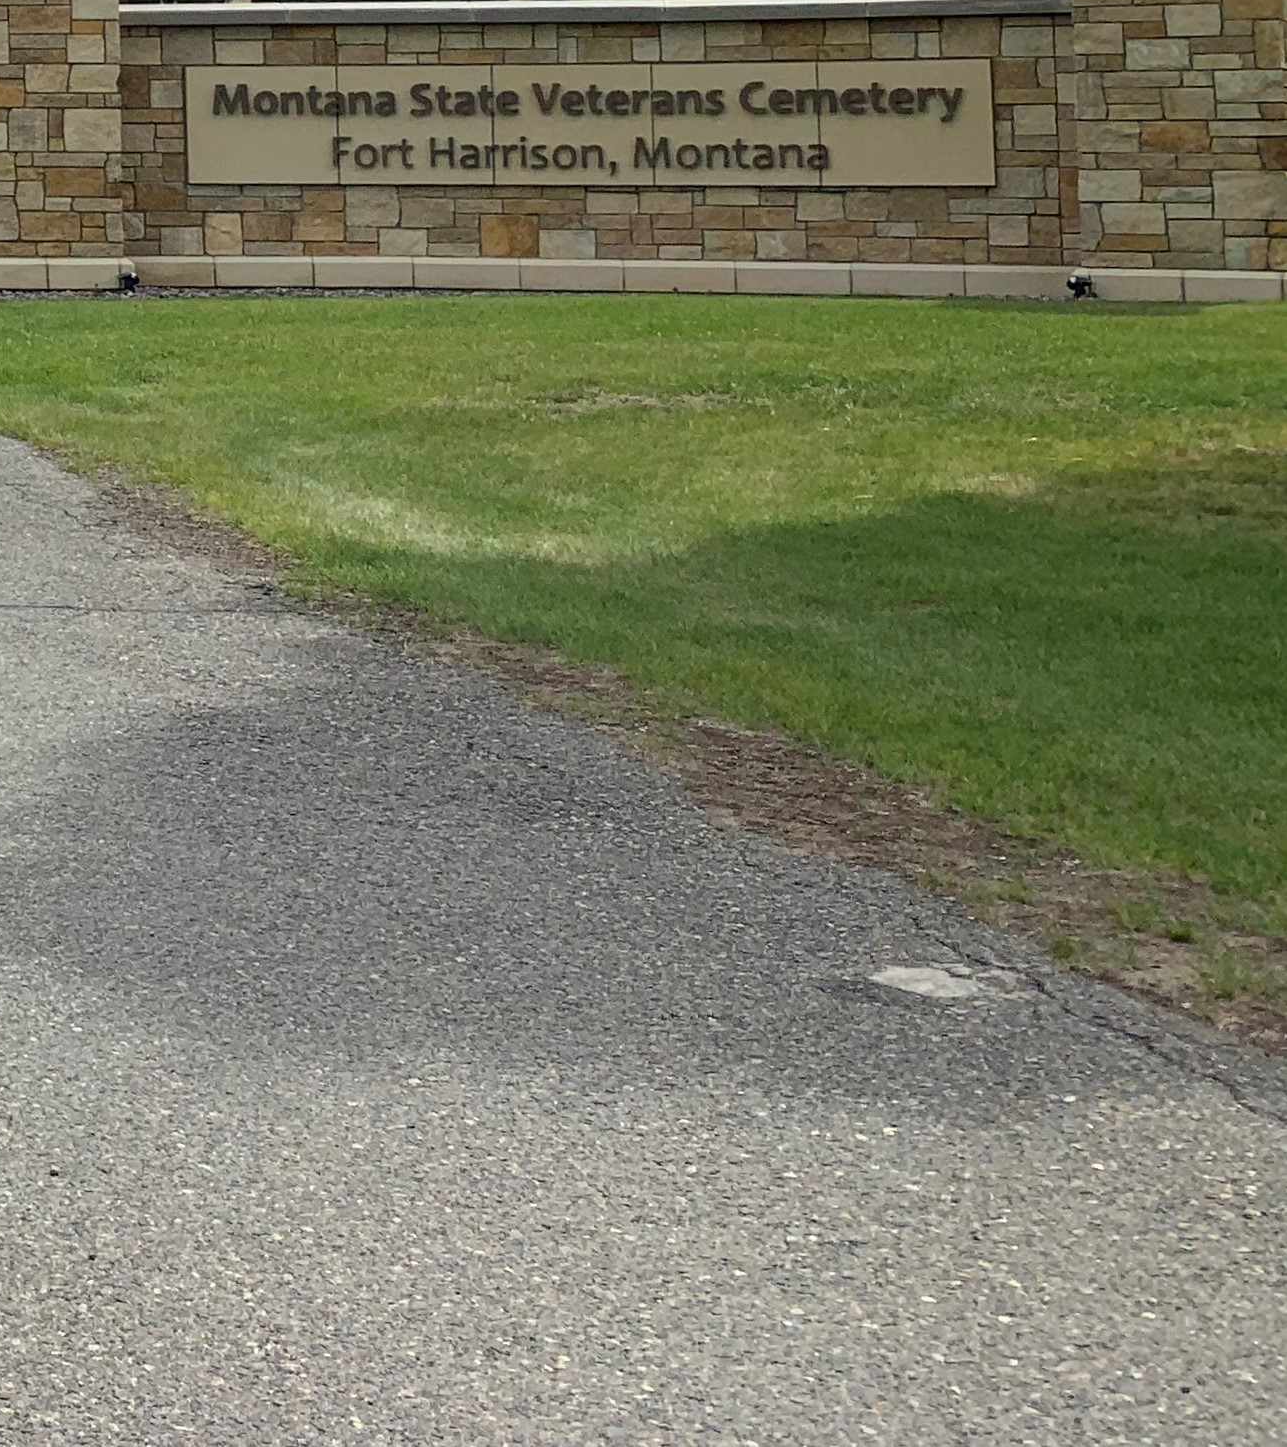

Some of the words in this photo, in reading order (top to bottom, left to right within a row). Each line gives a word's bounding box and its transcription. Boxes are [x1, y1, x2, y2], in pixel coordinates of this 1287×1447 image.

[212, 84, 397, 117] Montana
[410, 83, 520, 117] State
[532, 82, 725, 116] Veterans
[738, 81, 963, 122] Cemetery
[332, 136, 414, 170] Fort
[429, 136, 619, 176] Harrison,
[633, 136, 830, 170] Montana
